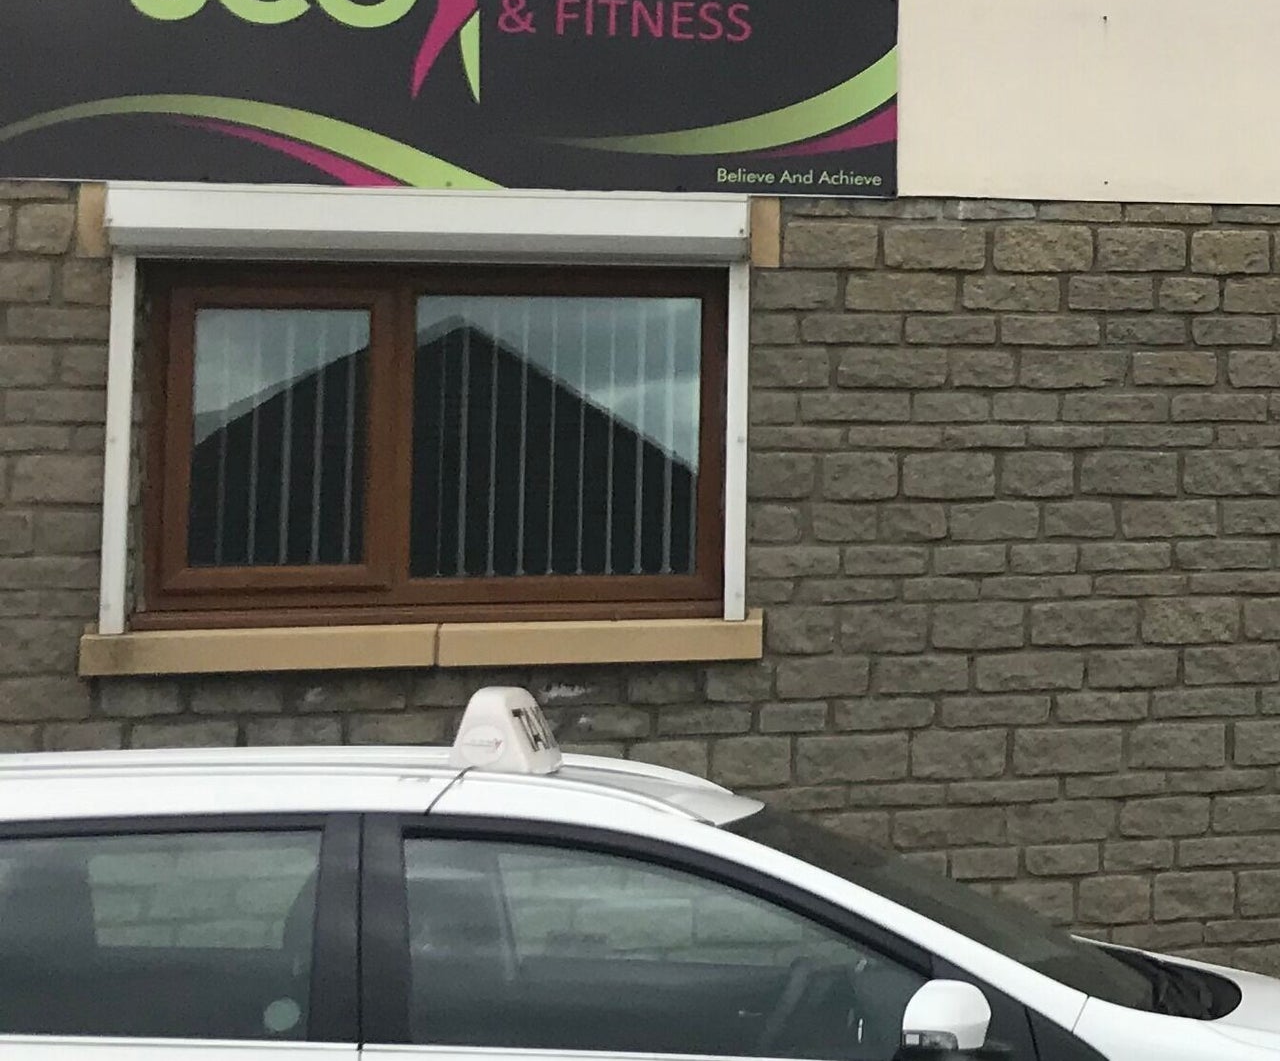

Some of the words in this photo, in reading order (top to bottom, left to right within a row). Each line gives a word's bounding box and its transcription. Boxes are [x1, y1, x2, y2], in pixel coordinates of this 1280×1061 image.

[716, 167, 775, 184] Believe
[780, 169, 814, 185] And
[818, 169, 882, 186] Achieve
